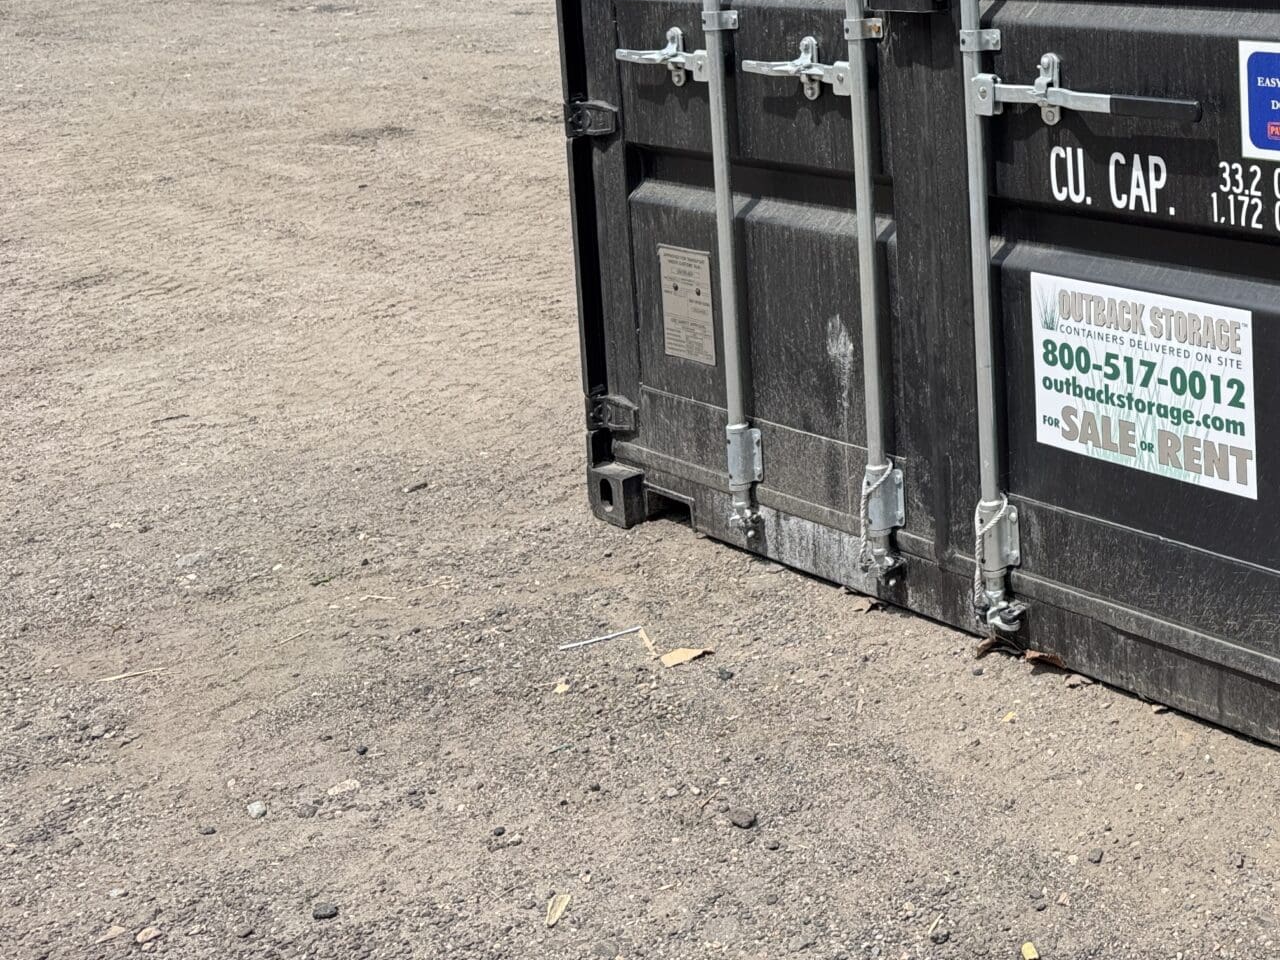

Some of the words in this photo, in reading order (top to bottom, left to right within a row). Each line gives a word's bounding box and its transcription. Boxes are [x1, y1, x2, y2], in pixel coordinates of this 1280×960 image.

[1050, 146, 1092, 205] CU.
[1109, 152, 1175, 216] CAP.
[1218, 161, 1262, 197] 33.2
[1210, 192, 1263, 229] 1,172
[1058, 289, 1146, 337] OUTBACK
[1149, 305, 1242, 355] STORAGE
[1059, 324, 1125, 346] CONTAINERS
[1129, 338, 1191, 359] DELIVERED
[1195, 352, 1212, 364] ON
[1217, 356, 1243, 370] SITE
[1042, 338, 1246, 409] 800-517-0012
[1042, 375, 1246, 437] outbackstorage.com
[1042, 414, 1060, 428] FOR
[1061, 405, 1137, 458] SALE
[1139, 440, 1155, 453] OR
[1157, 428, 1253, 486] RENT
